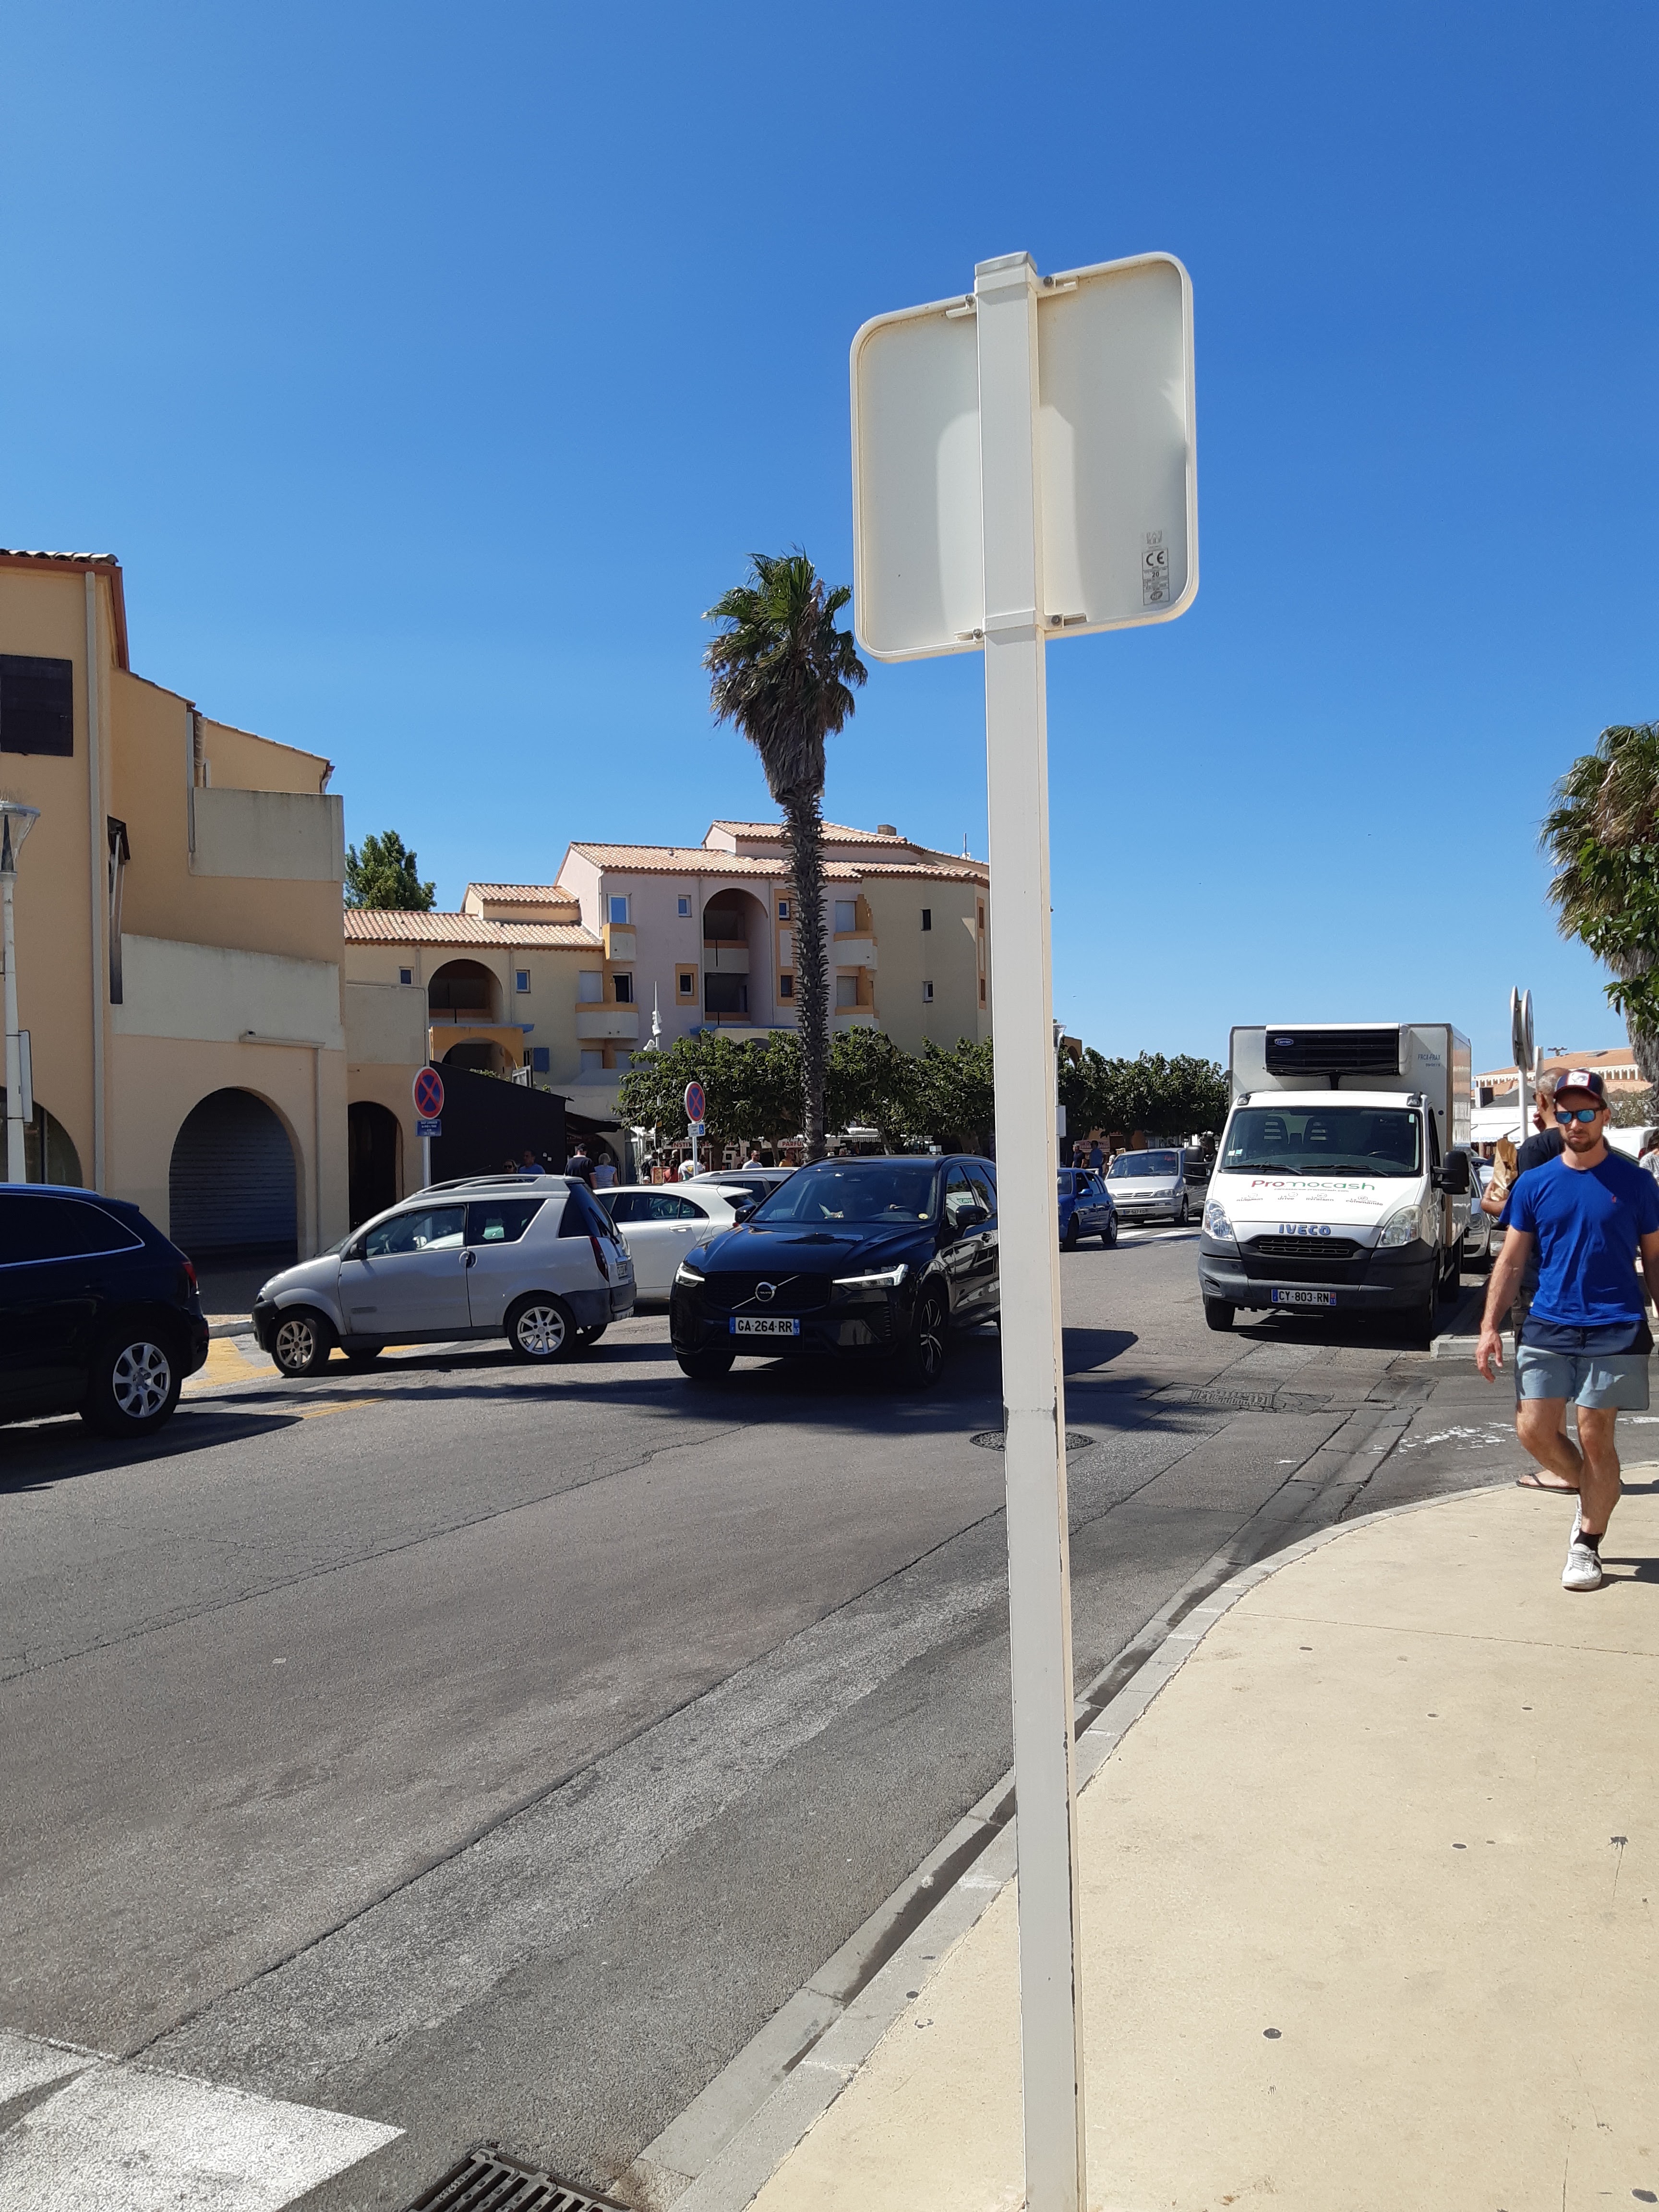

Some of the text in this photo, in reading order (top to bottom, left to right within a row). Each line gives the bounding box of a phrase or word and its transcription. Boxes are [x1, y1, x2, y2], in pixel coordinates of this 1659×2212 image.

[1146, 551, 1165, 566] CE
[1251, 1180, 1375, 1190] Promocash
[1278, 1224, 1331, 1236] IVECO
[1279, 1291, 1329, 1303] CY-803-RN
[738, 1320, 793, 1333] GA-264-RR
